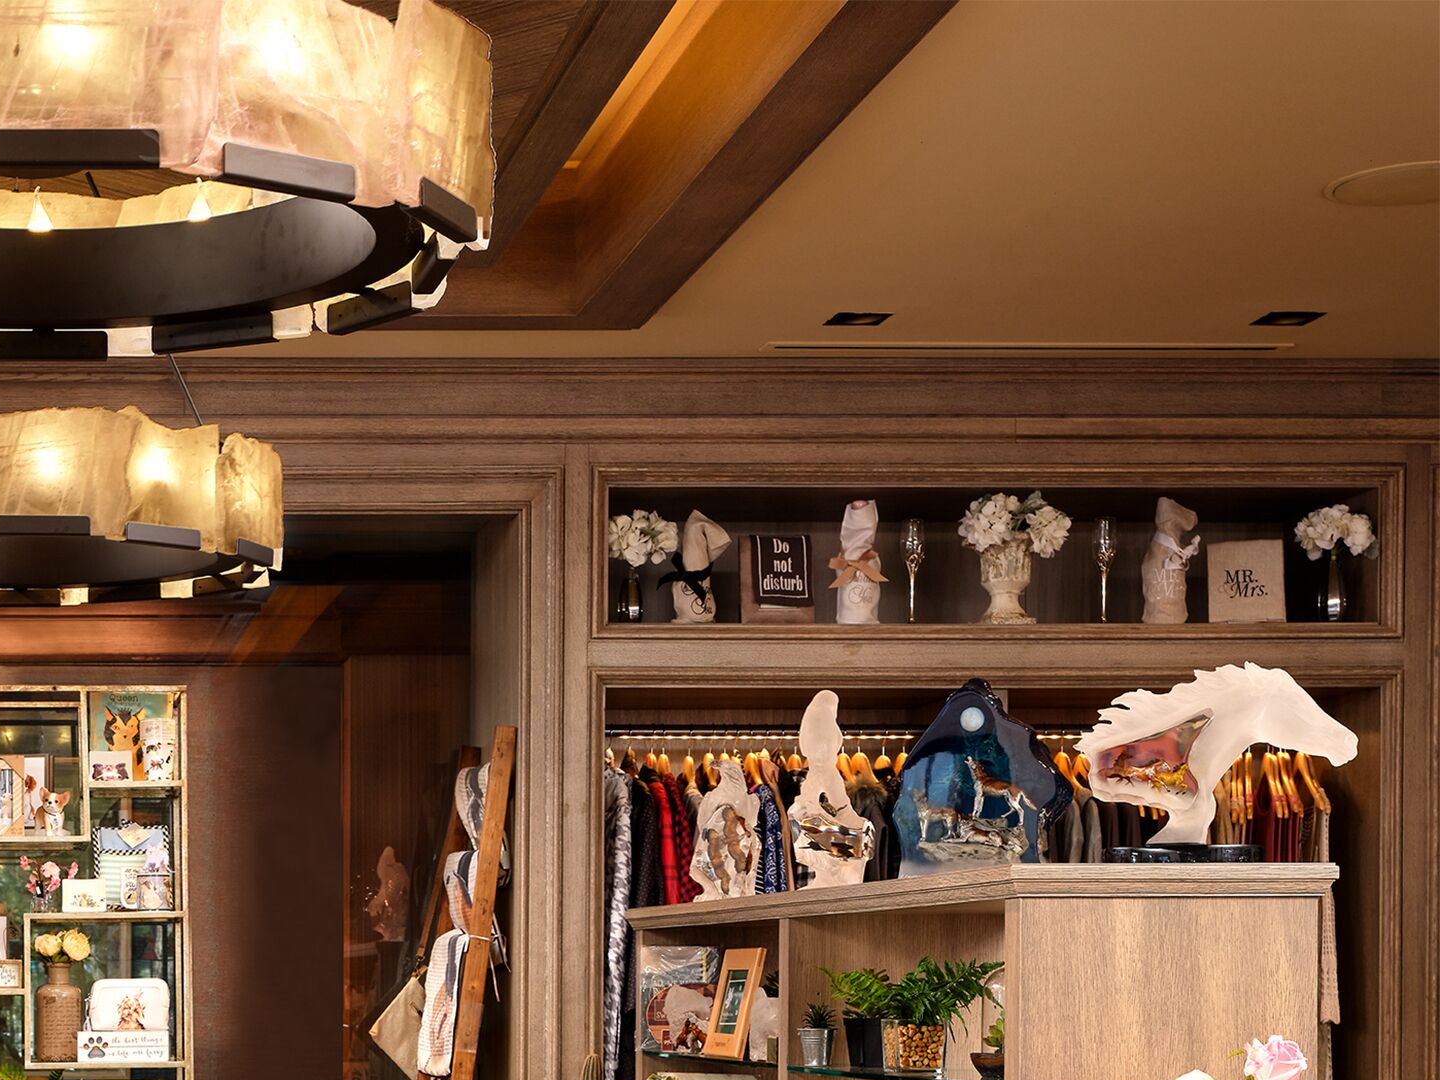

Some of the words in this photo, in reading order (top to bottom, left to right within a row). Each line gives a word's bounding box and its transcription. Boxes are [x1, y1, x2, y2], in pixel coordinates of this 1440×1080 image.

[772, 538, 790, 554] Do
[773, 556, 793, 573] not
[763, 573, 804, 591] disturb
[1224, 569, 1259, 584] MR.
[1229, 581, 1269, 599] Mrs.
[109, 693, 139, 703] Queen
